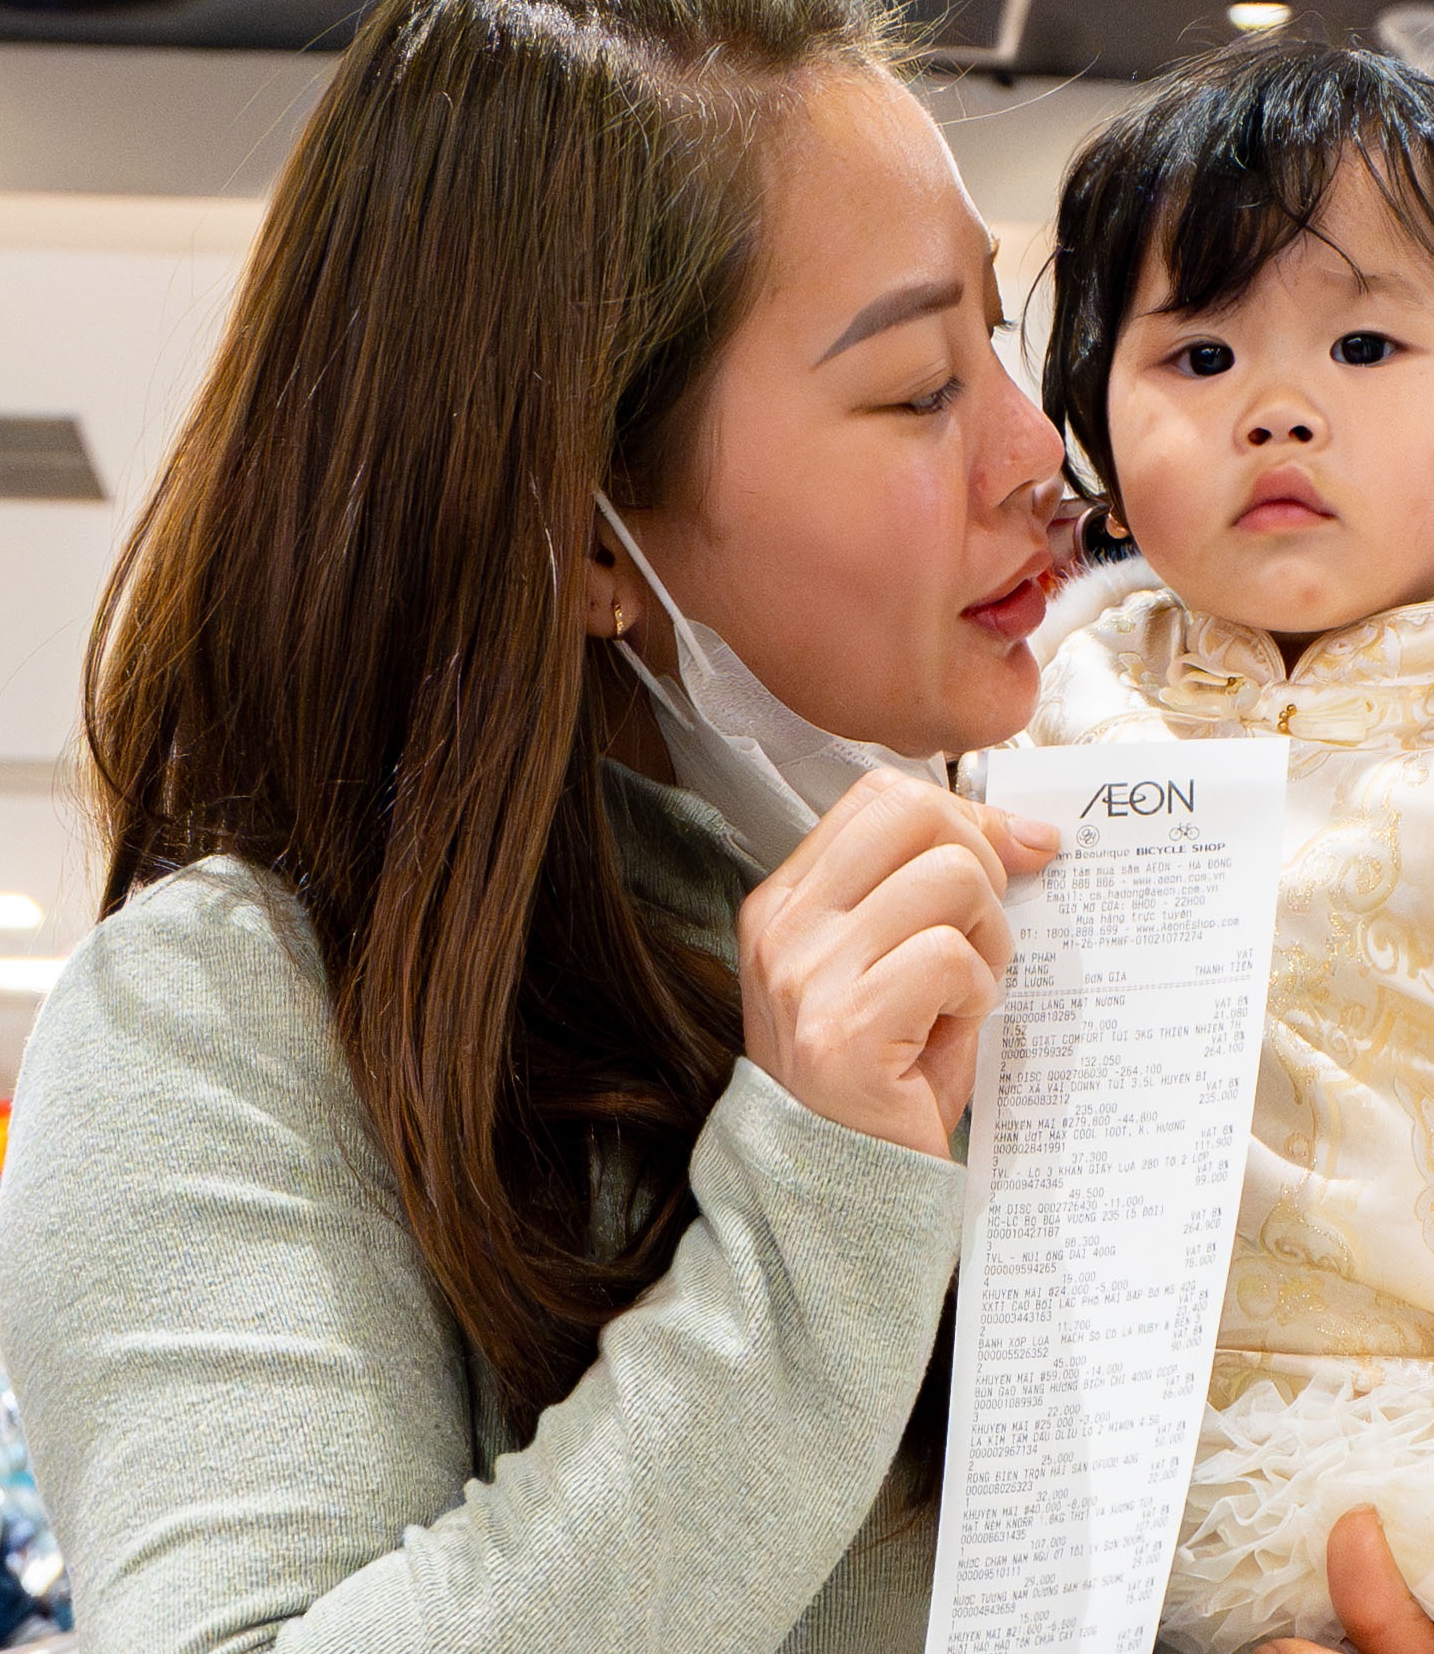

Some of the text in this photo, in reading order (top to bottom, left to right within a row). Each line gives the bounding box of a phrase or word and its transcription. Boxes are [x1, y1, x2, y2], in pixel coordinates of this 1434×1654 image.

[1079, 779, 1194, 819] ÆON
[1136, 844, 1186, 856] BICYCLE
[1192, 842, 1226, 853] SHOP
[1000, 1061, 1006, 1071] 2
